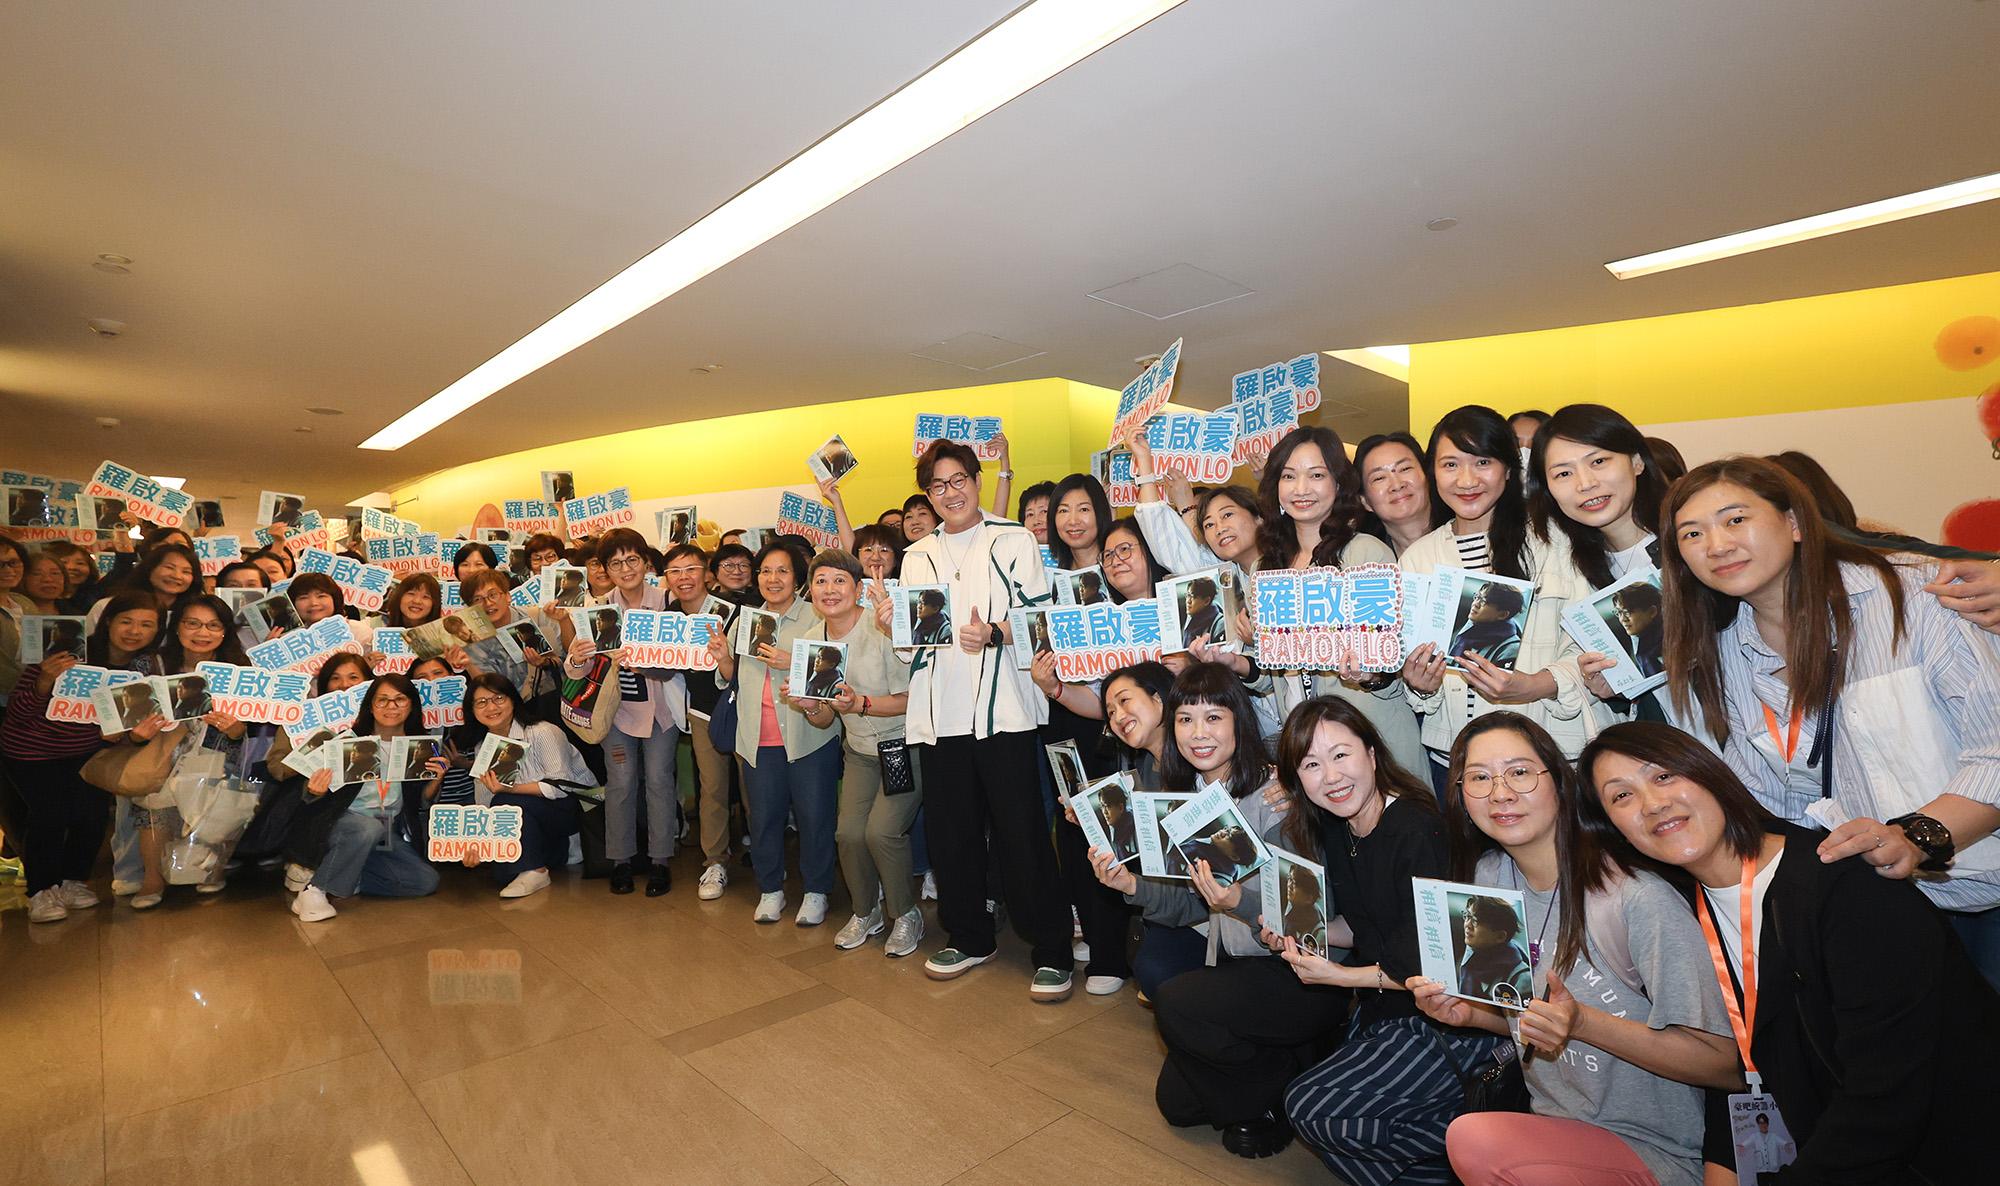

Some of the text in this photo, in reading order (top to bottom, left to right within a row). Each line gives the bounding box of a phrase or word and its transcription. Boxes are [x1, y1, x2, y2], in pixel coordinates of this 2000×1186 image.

[1117, 345, 1179, 420] 羅啟豪
[1236, 356, 1316, 403] 羅啟豪
[1151, 383, 1171, 412] LO
[1296, 390, 1317, 409] LO
[917, 415, 1000, 441] 羅啟豪
[1203, 457, 1230, 480] LO
[98, 463, 190, 514] 羅啟豪
[156, 510, 179, 527] LO
[566, 488, 630, 522] 羅啟豪
[617, 510, 633, 524] LO
[73, 530, 94, 543] LO
[313, 530, 328, 544] LO
[369, 533, 438, 560] 羅啟豪
[824, 534, 840, 549] LO
[301, 550, 389, 593] 羅啟豪
[358, 592, 380, 608] LO
[1257, 572, 1396, 626] 羅啟豪
[625, 612, 718, 645] 羅啟豪
[1050, 603, 1160, 649] 羅啟豪
[252, 617, 351, 671] 羅啟豪
[623, 647, 716, 668] RAMON LO
[1260, 632, 1398, 665] RAMON LO
[200, 664, 309, 702] 羅啟豪
[273, 701, 302, 722] LO
[433, 809, 519, 837] 羅啟豪
[497, 841, 518, 858] LO
